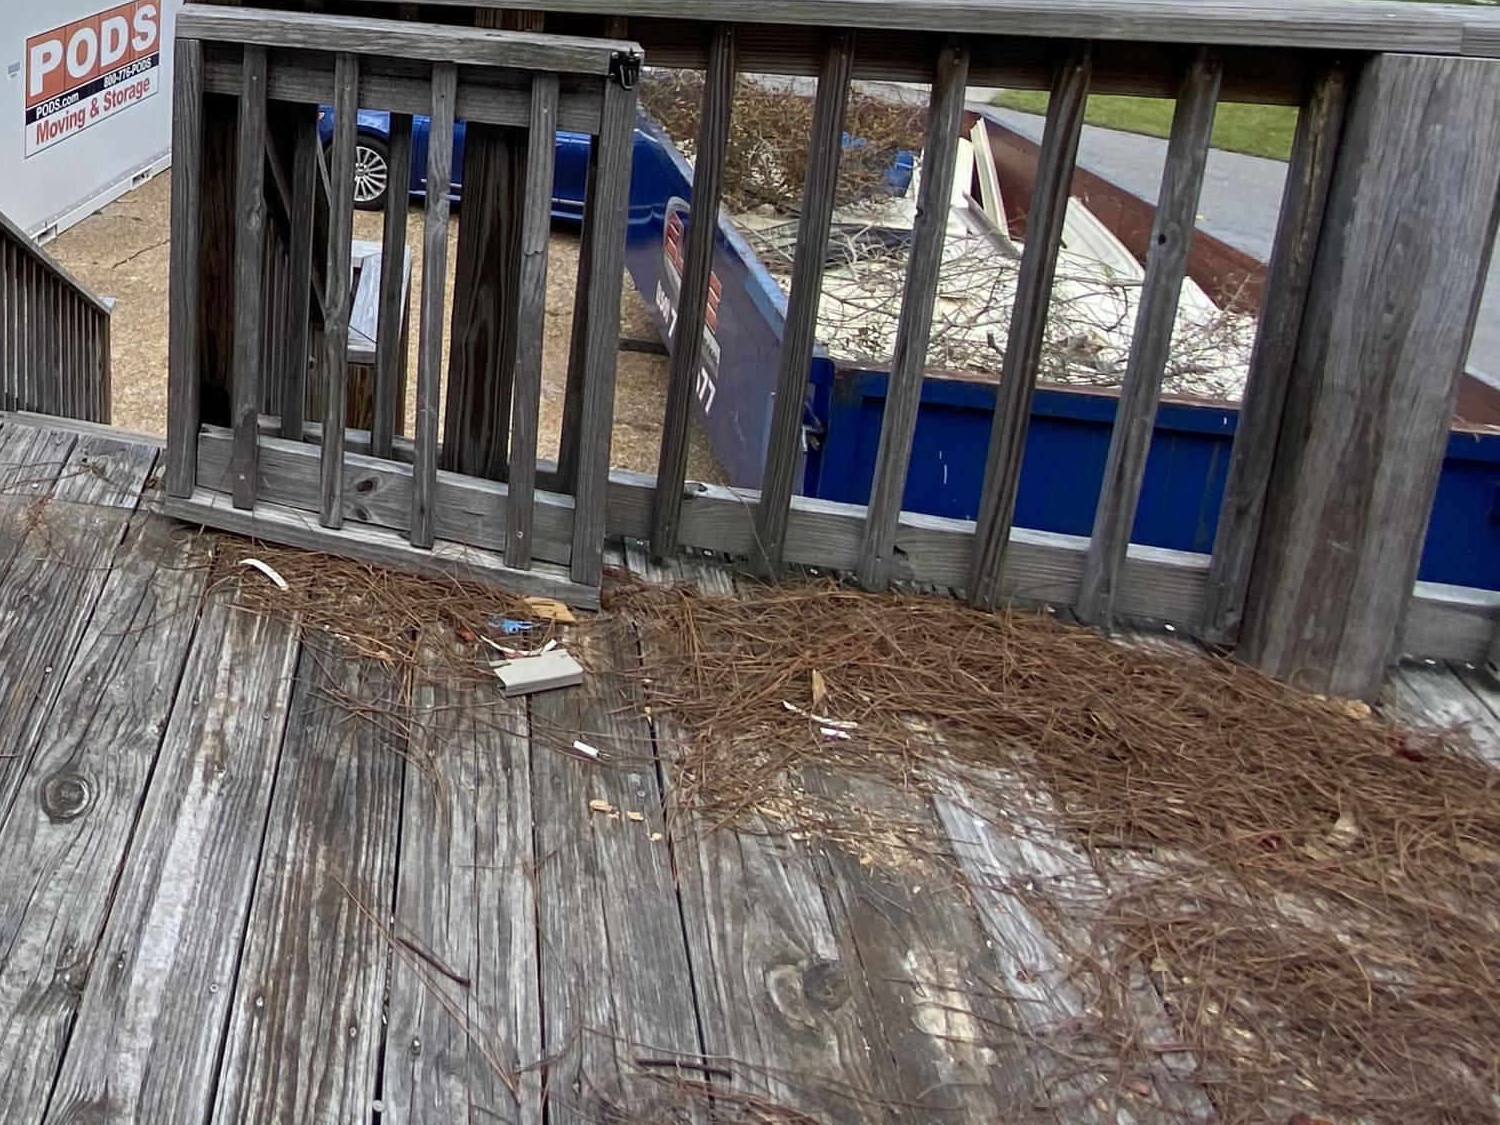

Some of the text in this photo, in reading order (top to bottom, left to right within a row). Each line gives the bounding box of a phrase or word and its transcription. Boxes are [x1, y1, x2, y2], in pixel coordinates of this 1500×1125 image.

[30, 4, 157, 97] PODS
[36, 58, 152, 120] PODS.com 800-776-PODS
[36, 77, 151, 145] Moving & Storage
